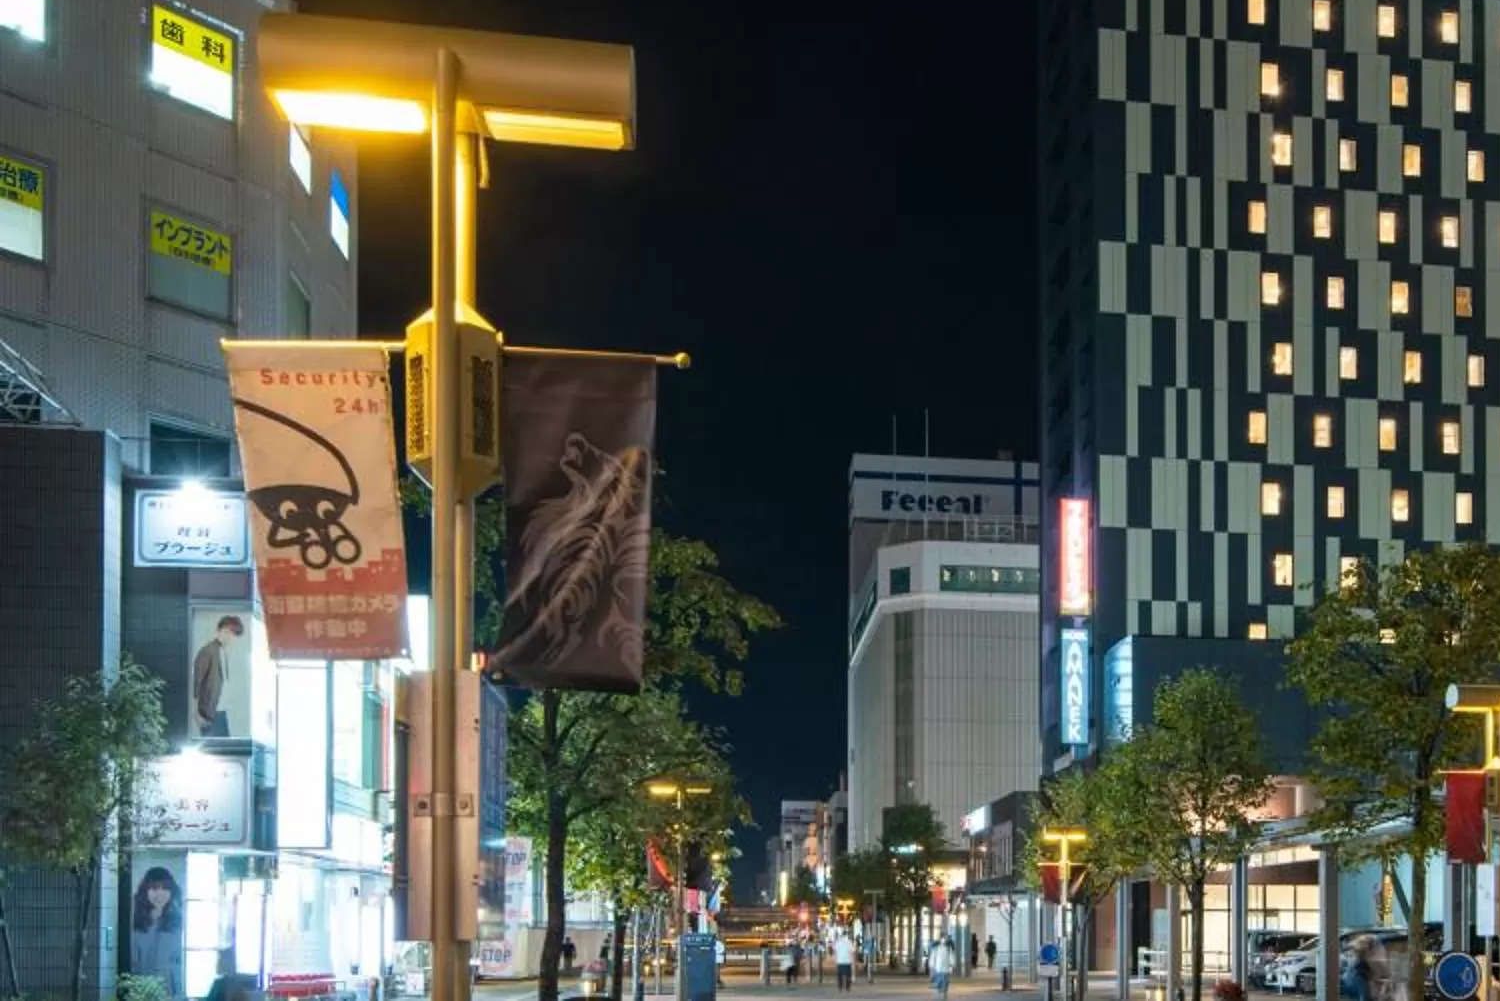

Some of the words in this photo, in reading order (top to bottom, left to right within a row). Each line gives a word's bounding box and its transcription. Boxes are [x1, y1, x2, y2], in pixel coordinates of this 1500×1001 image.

[160, 17, 225, 64] 歯科
[155, 218, 229, 260] インプラント
[260, 368, 377, 388] Security
[333, 397, 379, 415] 24h
